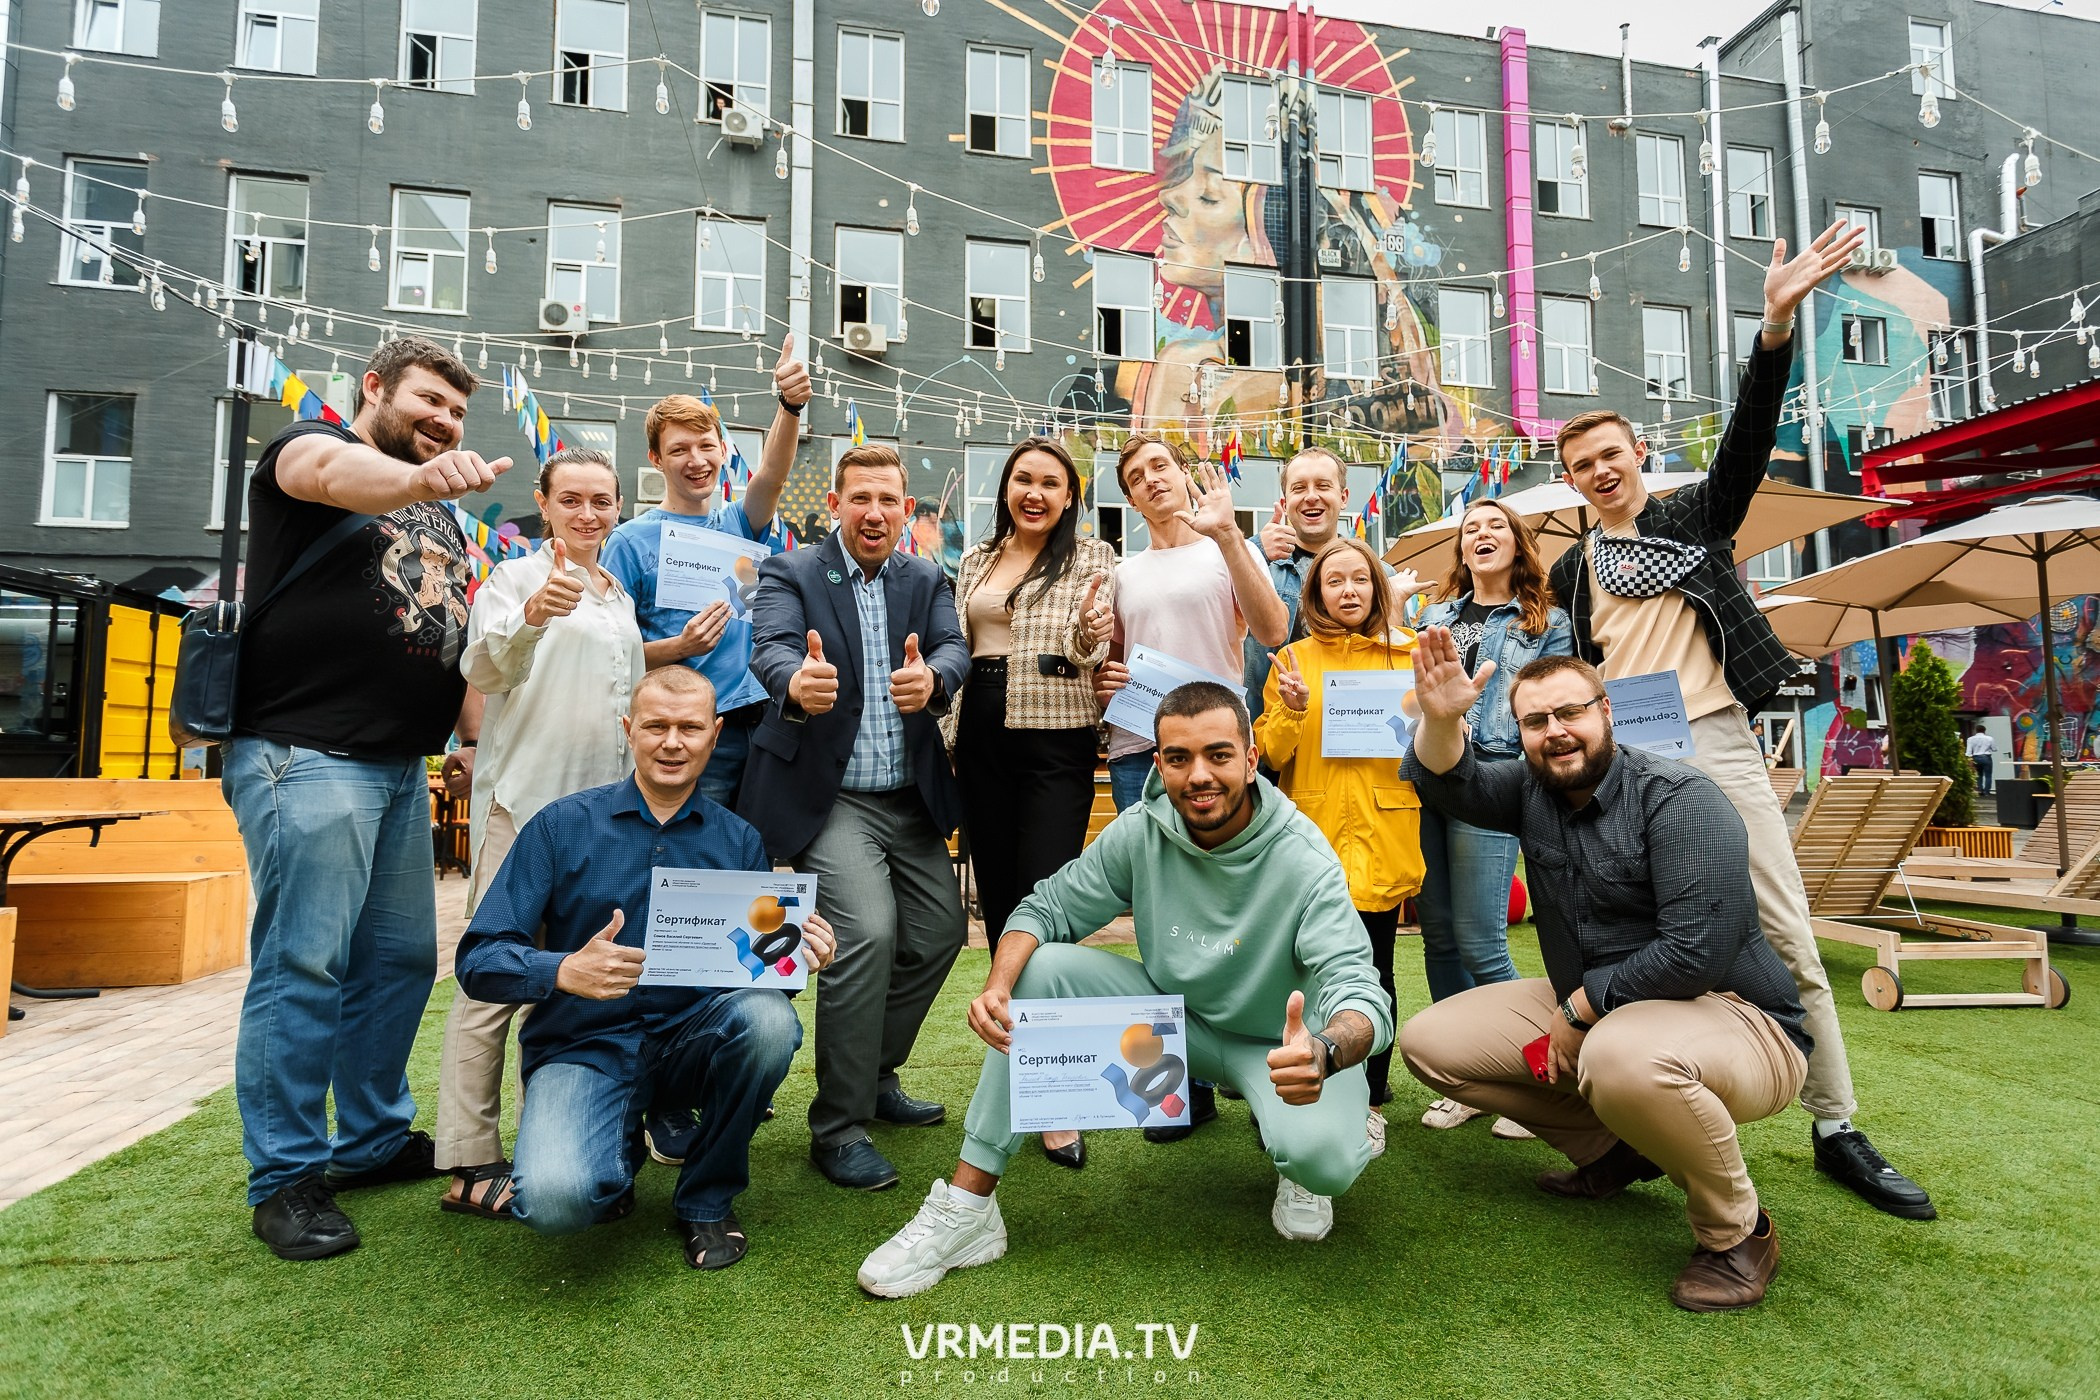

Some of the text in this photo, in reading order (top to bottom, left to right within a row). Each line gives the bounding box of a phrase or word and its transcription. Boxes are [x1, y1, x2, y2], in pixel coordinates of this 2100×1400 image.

[665, 557, 721, 573] Сертификат
[1127, 677, 1167, 699] Сертифи
[1328, 707, 1385, 717] Сертификат
[1612, 712, 1679, 727] Сертификат
[656, 914, 727, 927] Сертификат
[1169, 925, 1234, 956] SALAM
[1018, 1053, 1098, 1068] Сертификат
